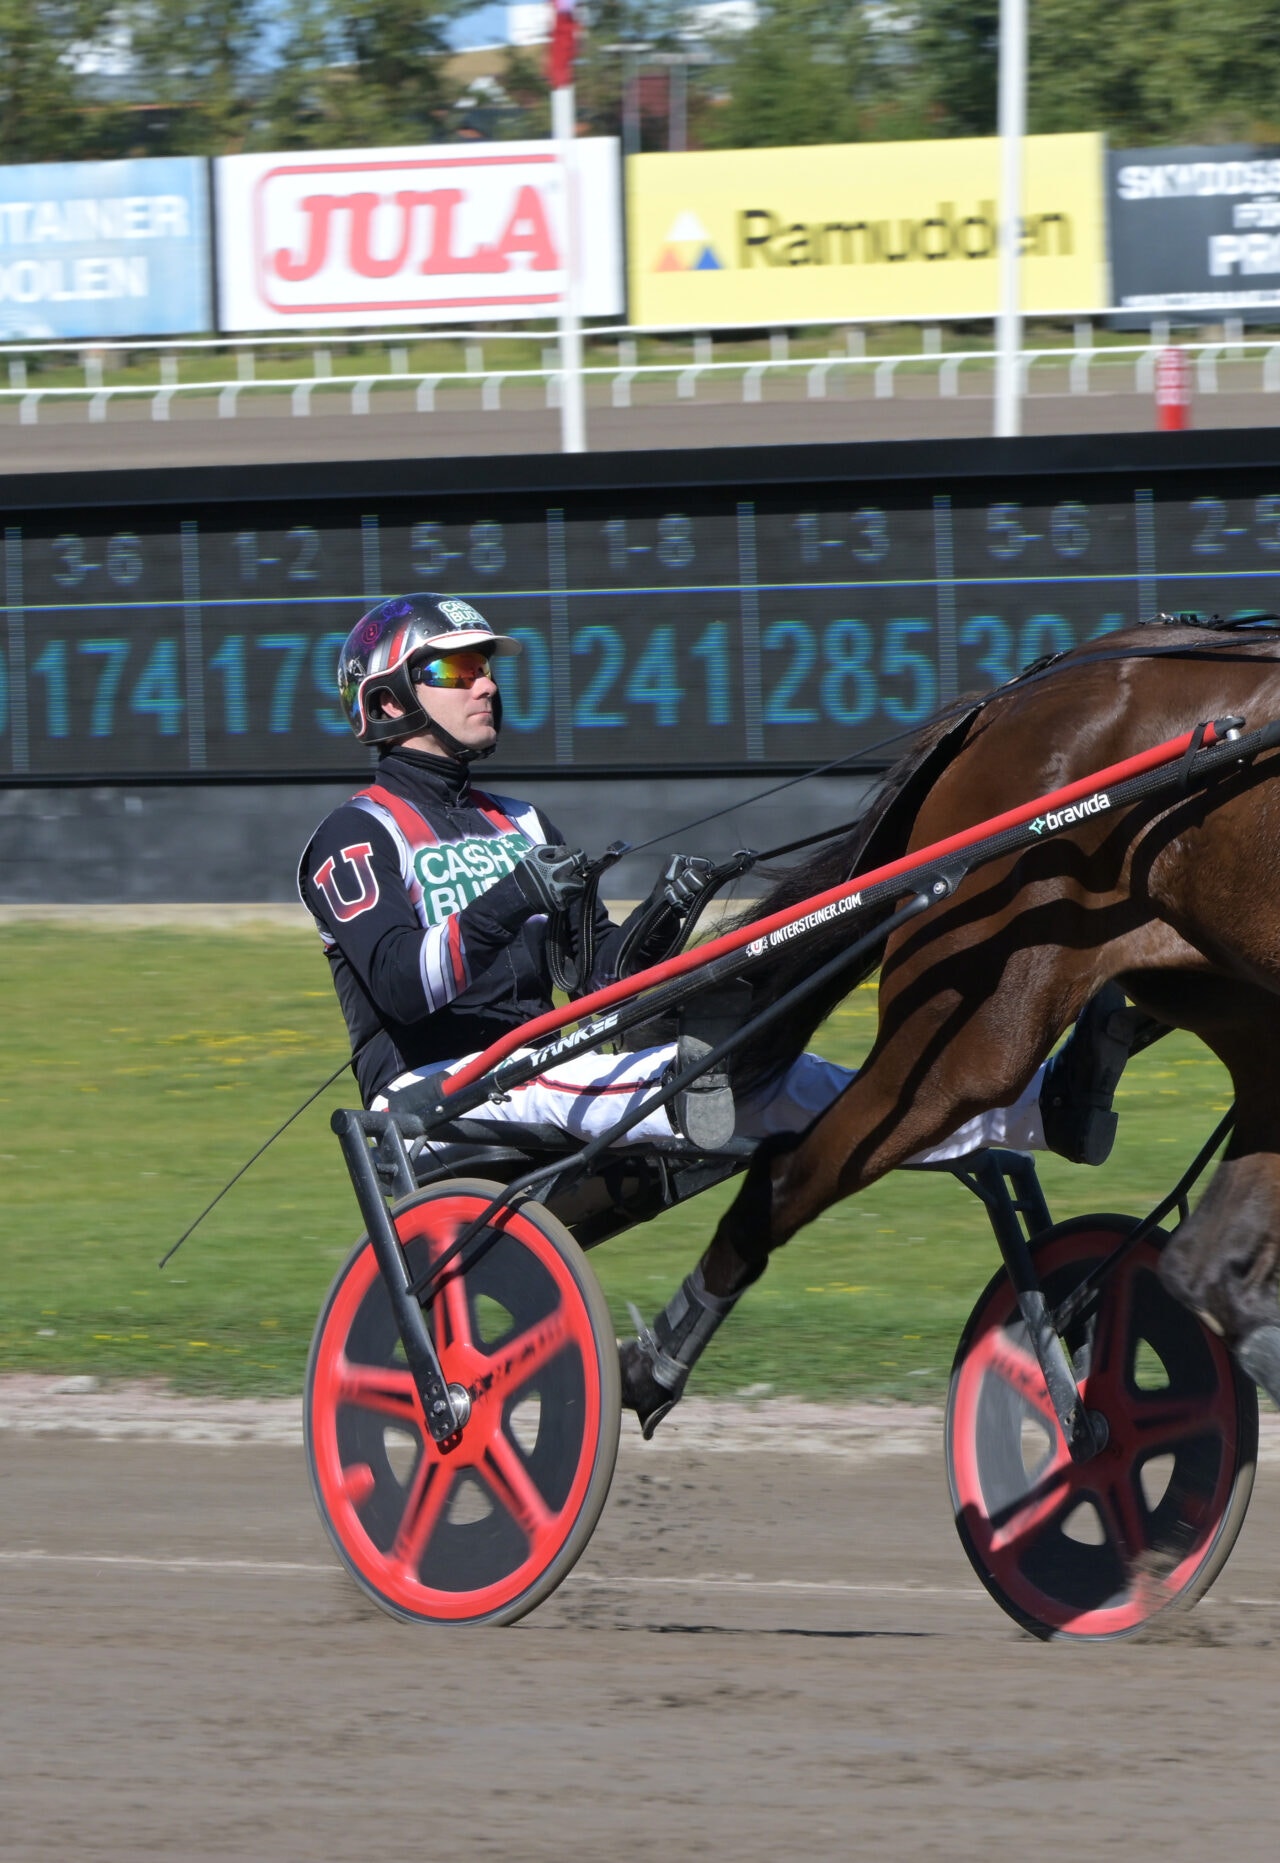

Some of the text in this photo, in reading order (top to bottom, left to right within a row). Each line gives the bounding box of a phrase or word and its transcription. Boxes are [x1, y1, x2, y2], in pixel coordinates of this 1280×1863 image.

[273, 184, 561, 282] JULA
[736, 199, 1074, 271] Ramudden
[51, 531, 145, 586] 3-6
[231, 525, 323, 581] 1-2
[410, 520, 507, 576] 5-8
[603, 513, 696, 569] 1-8
[793, 507, 891, 564] 1-3
[985, 501, 1091, 559] 5-6
[32, 638, 188, 738] 174
[570, 619, 734, 728] 241
[760, 617, 939, 726] 285
[957, 611, 1126, 683] 30
[1046, 793, 1111, 831] bravida
[313, 842, 380, 923] U
[420, 842, 516, 885] CASH
[770, 892, 862, 946] UNTERSTEINER.COM
